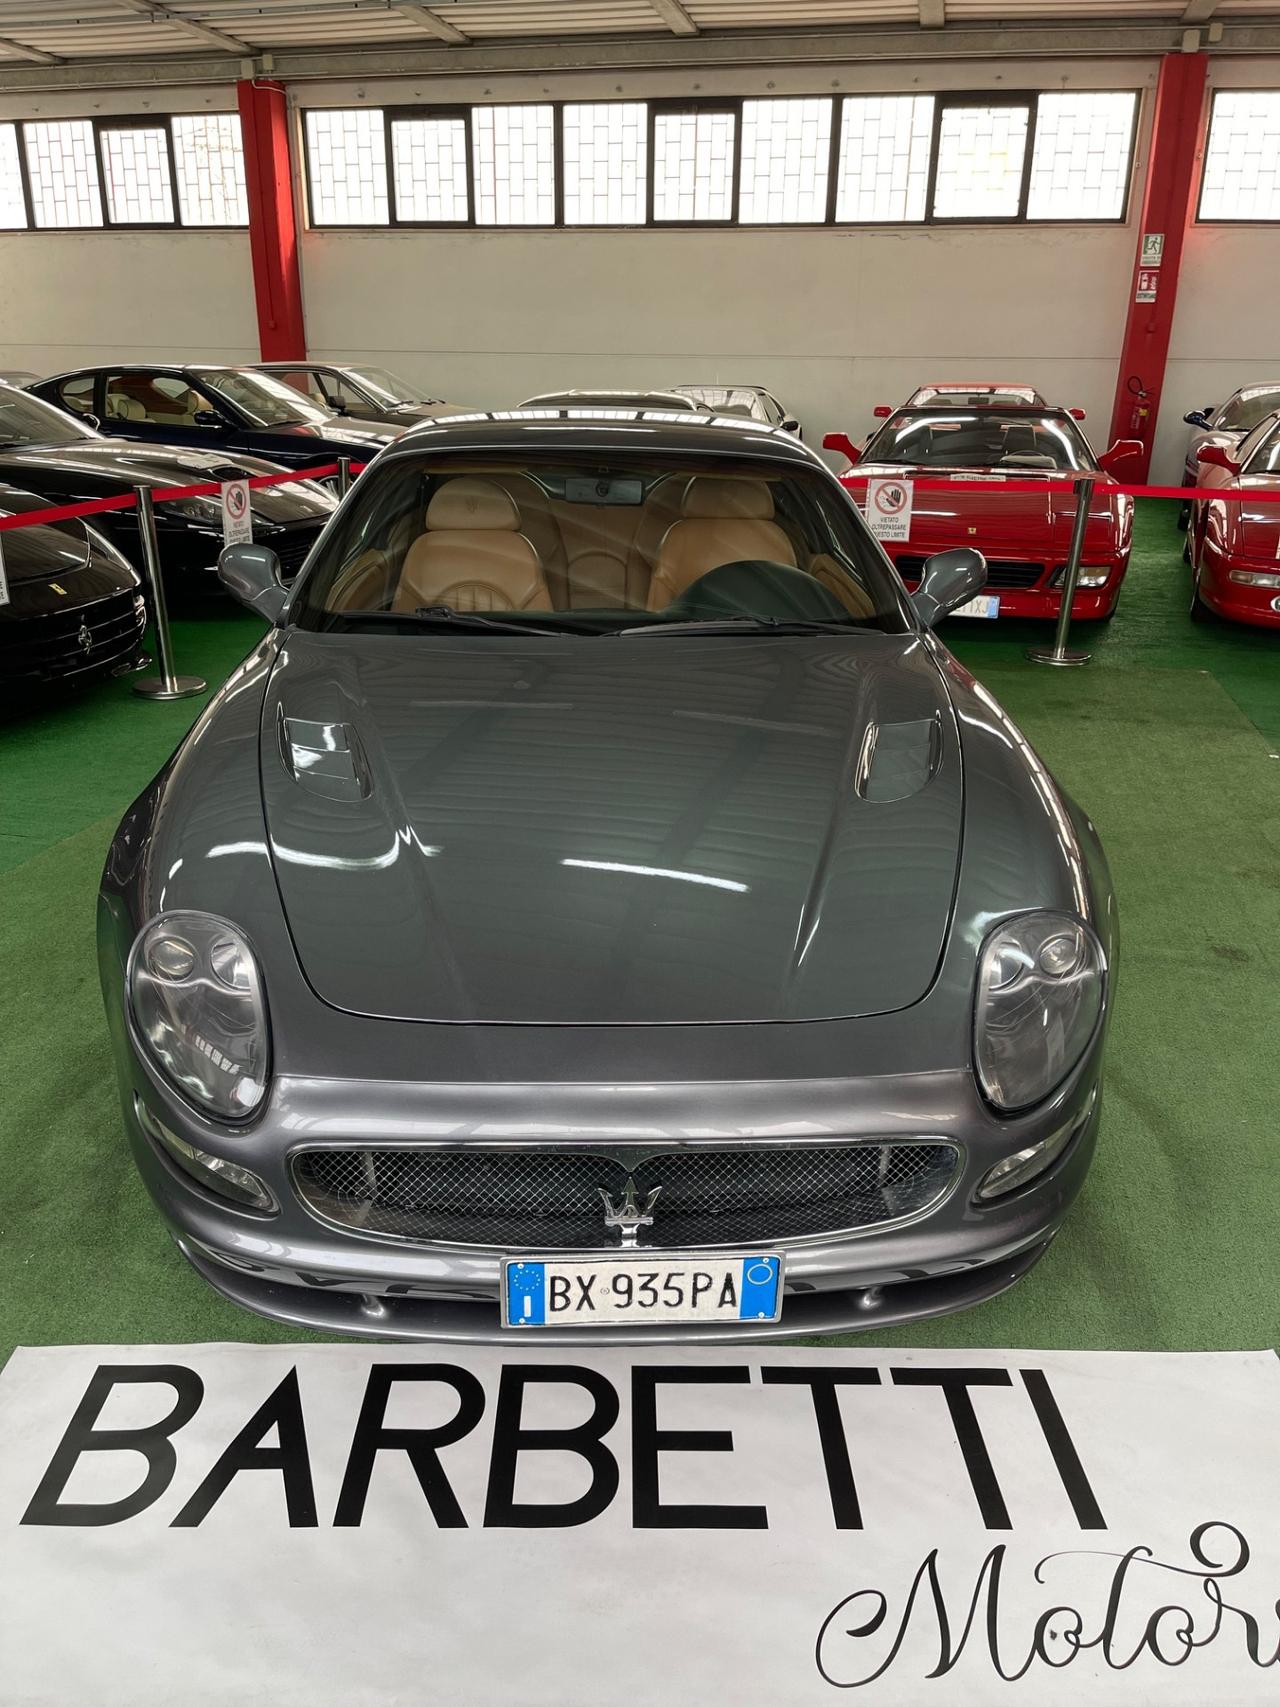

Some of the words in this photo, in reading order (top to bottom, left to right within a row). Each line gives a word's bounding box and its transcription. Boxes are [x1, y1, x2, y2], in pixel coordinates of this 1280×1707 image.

[550, 1275, 597, 1311] BX
[611, 1272, 738, 1309] 935PA
[20, 1363, 1107, 1529] BARBETTI
[816, 1522, 1280, 1688] Motor
